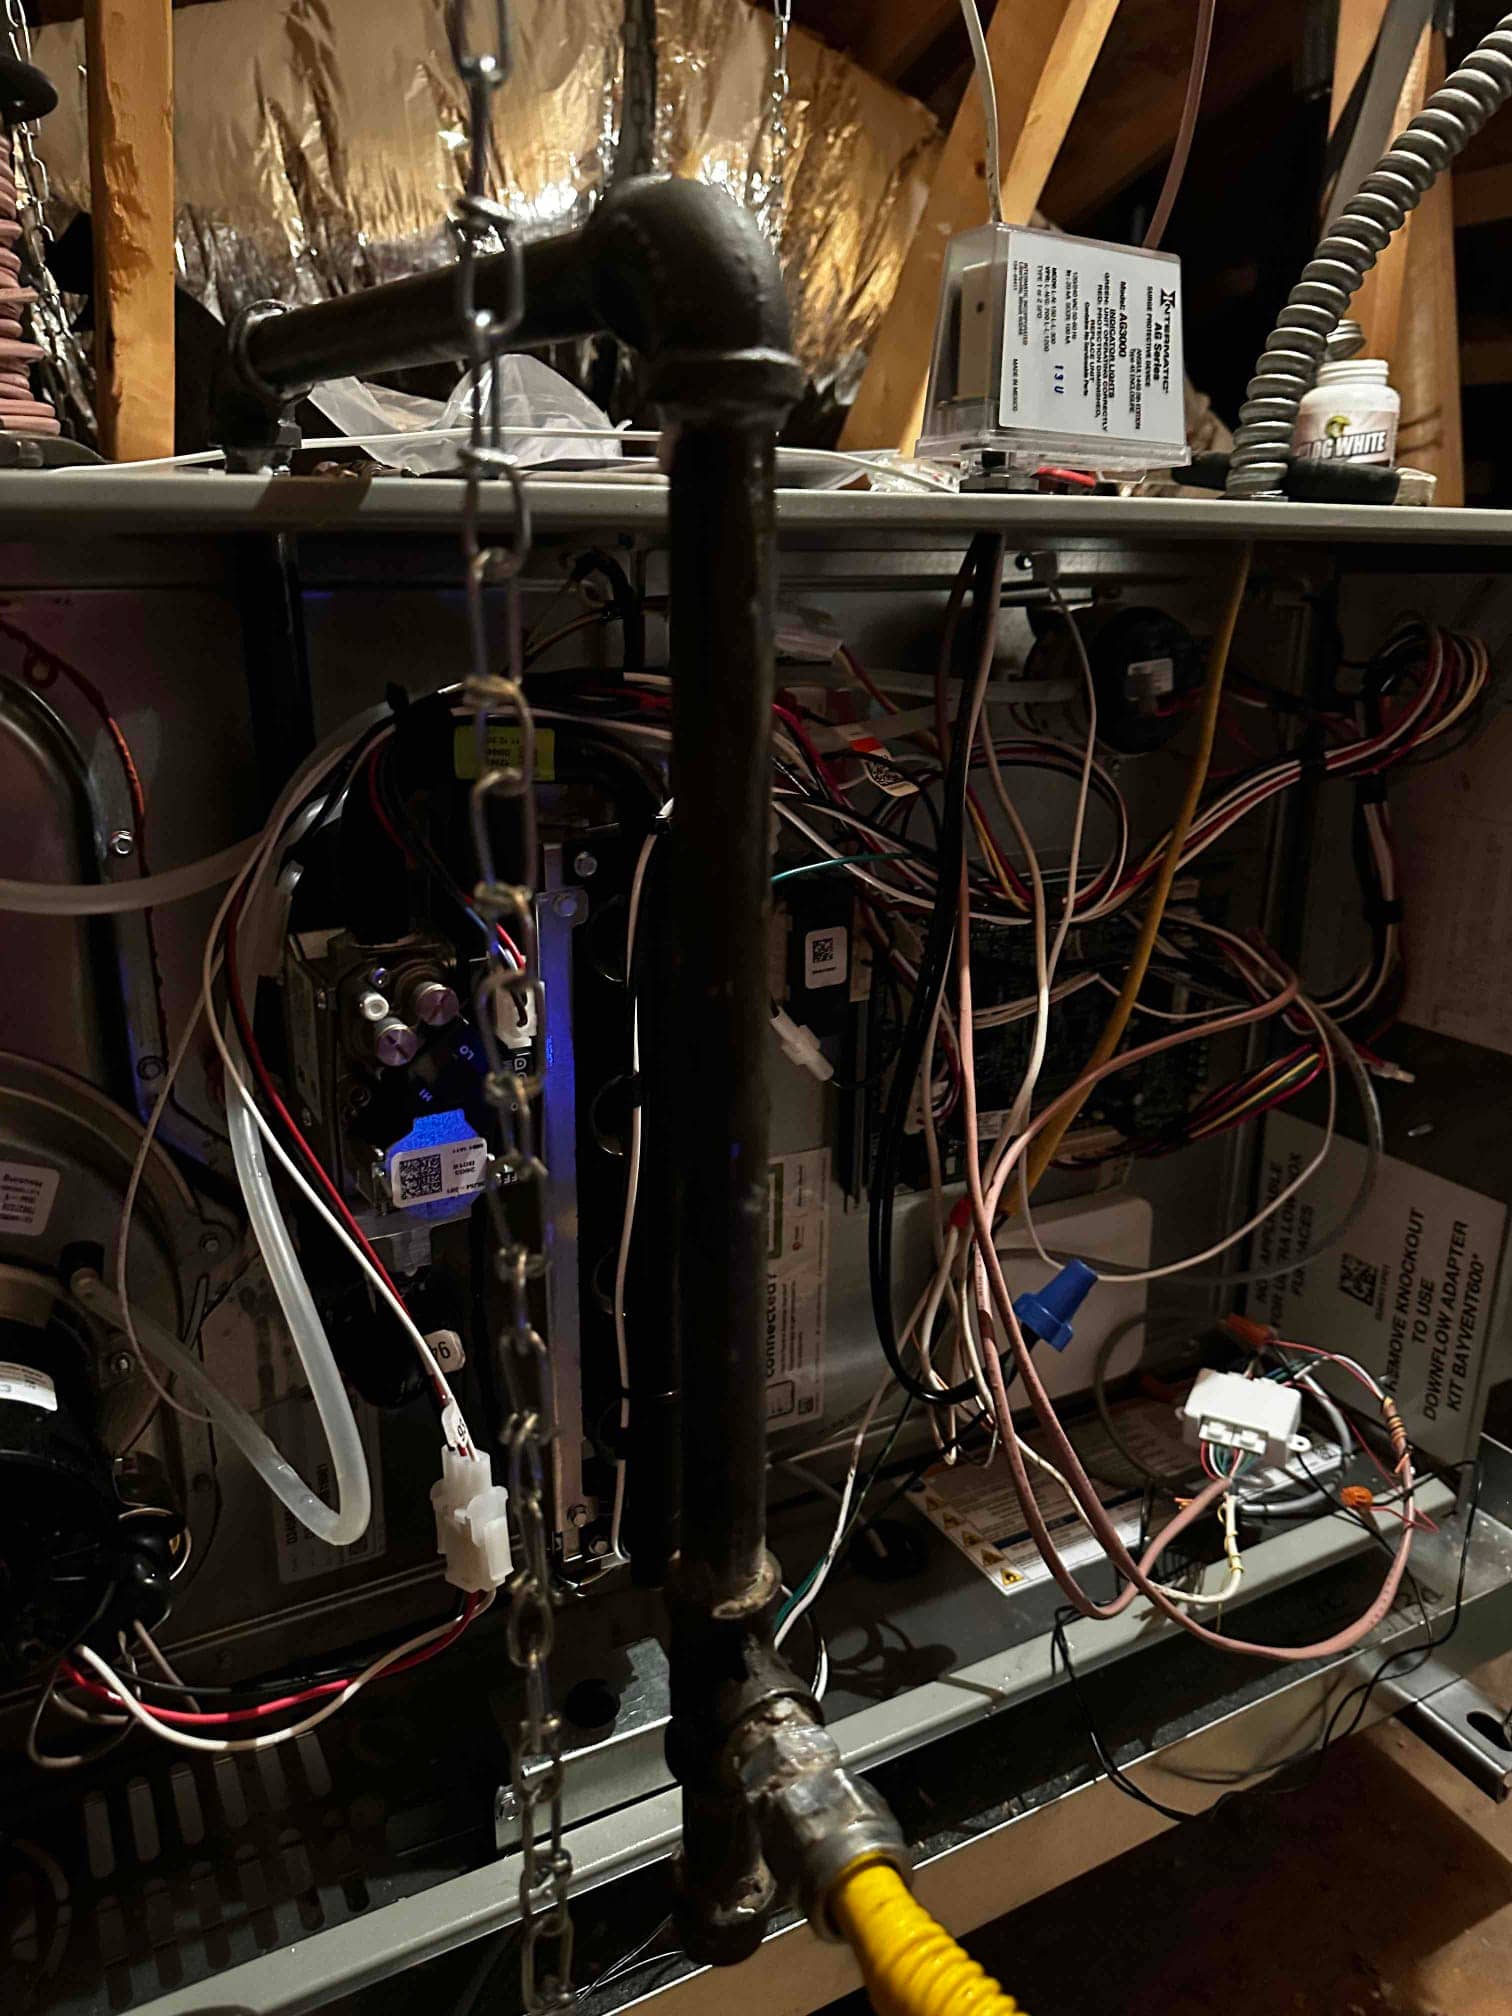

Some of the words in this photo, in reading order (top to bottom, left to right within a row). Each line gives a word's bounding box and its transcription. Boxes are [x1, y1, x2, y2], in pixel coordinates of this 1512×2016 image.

[1118, 312, 1127, 357] AG3000
[1154, 322, 1162, 340] AG
[1153, 342, 1162, 381] Series
[1054, 385, 1064, 394] U
[1335, 431, 1387, 457] WHITE
[1396, 1205, 1425, 1316] KNOCKOUT
[1415, 1274, 1434, 1318] USE
[1411, 1316, 1428, 1348] TO
[1422, 1308, 1452, 1423] DOWNFLOW
[1440, 1218, 1468, 1311] ADAPTER
[1384, 1313, 1409, 1394] REMOVE
[1446, 1377, 1463, 1413] KIT
